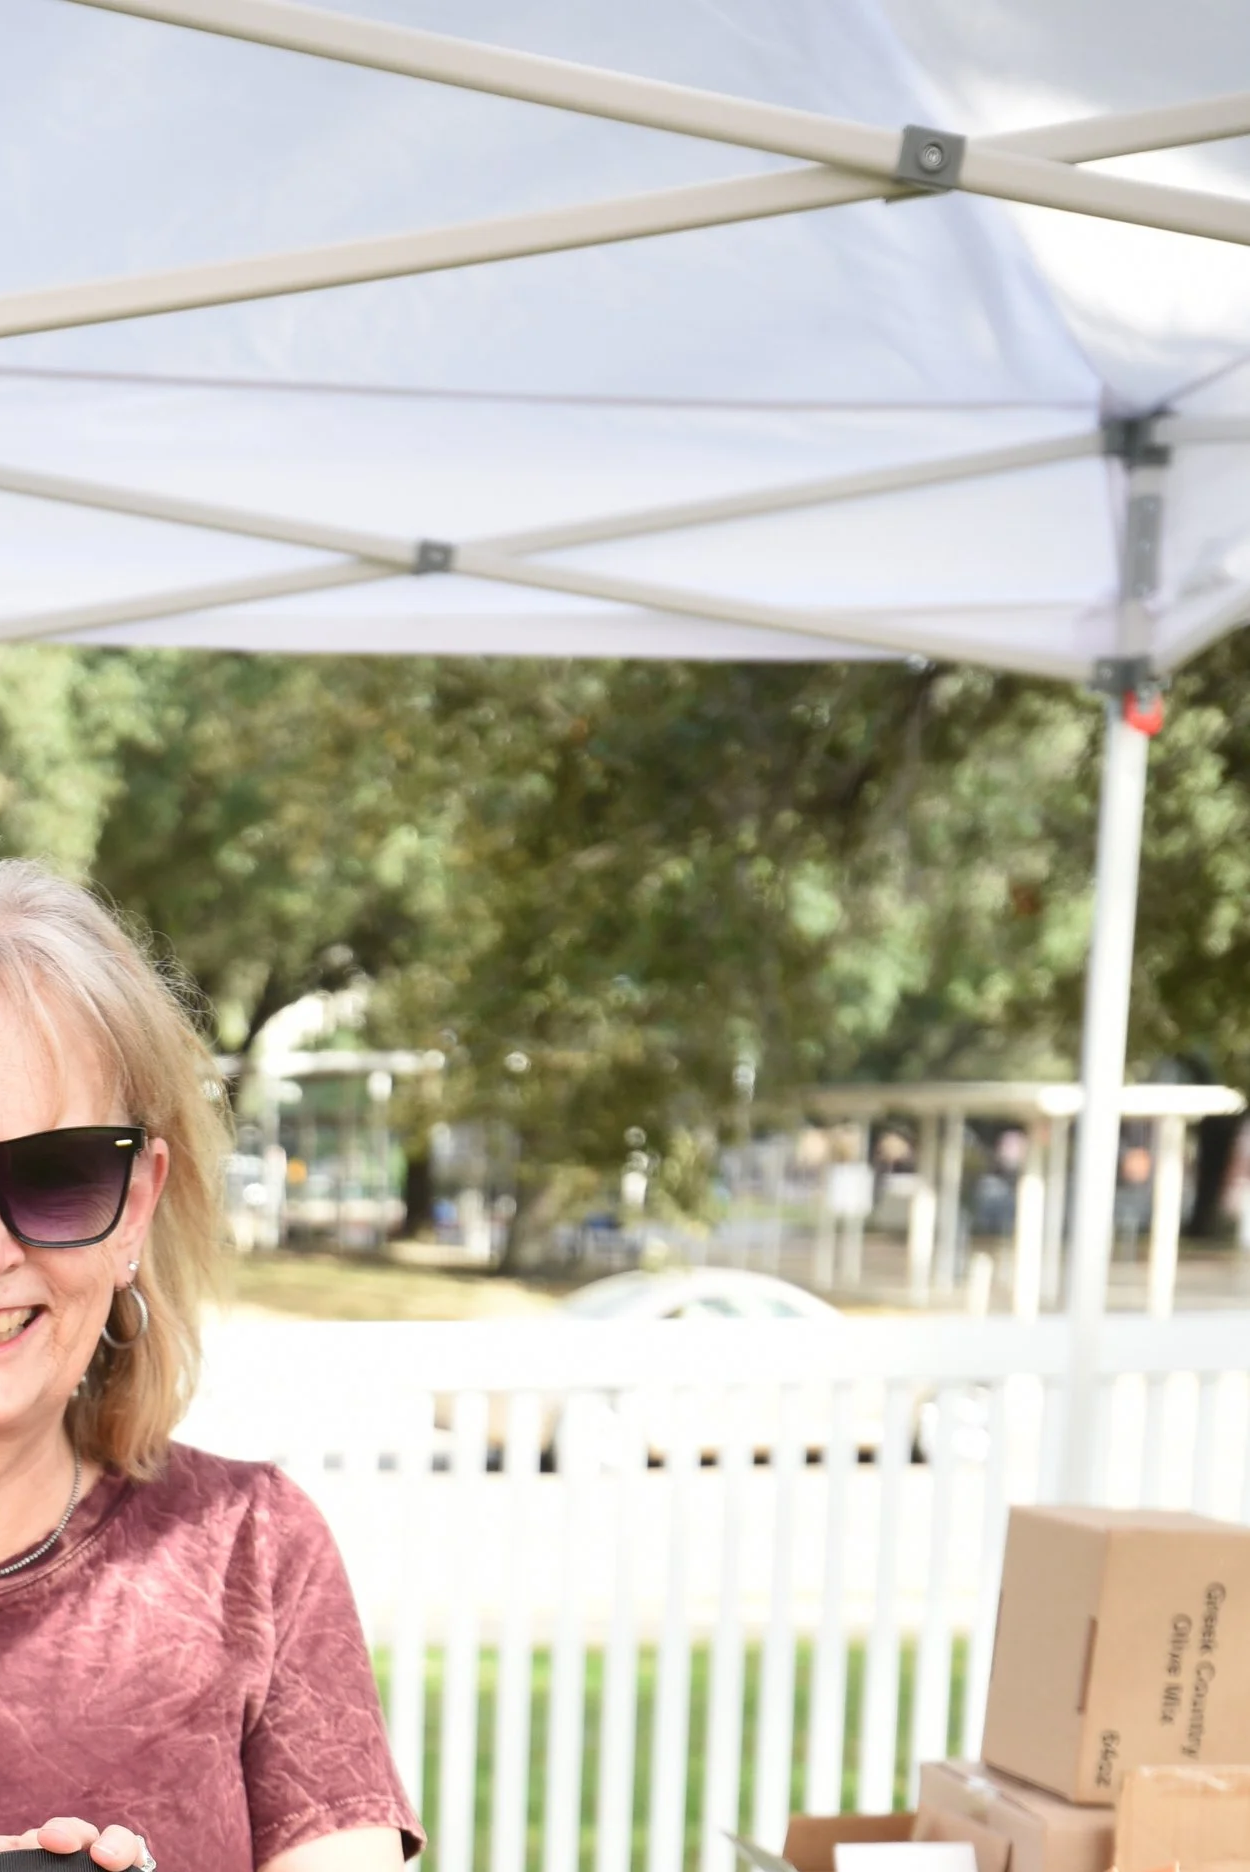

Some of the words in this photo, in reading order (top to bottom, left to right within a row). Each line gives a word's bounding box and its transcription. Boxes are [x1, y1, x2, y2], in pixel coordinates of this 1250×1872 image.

[1166, 1612, 1193, 1677] Olive
[1202, 1580, 1227, 1655] Greek
[1160, 1682, 1183, 1726] Mix
[1180, 1660, 1216, 1760] Country
